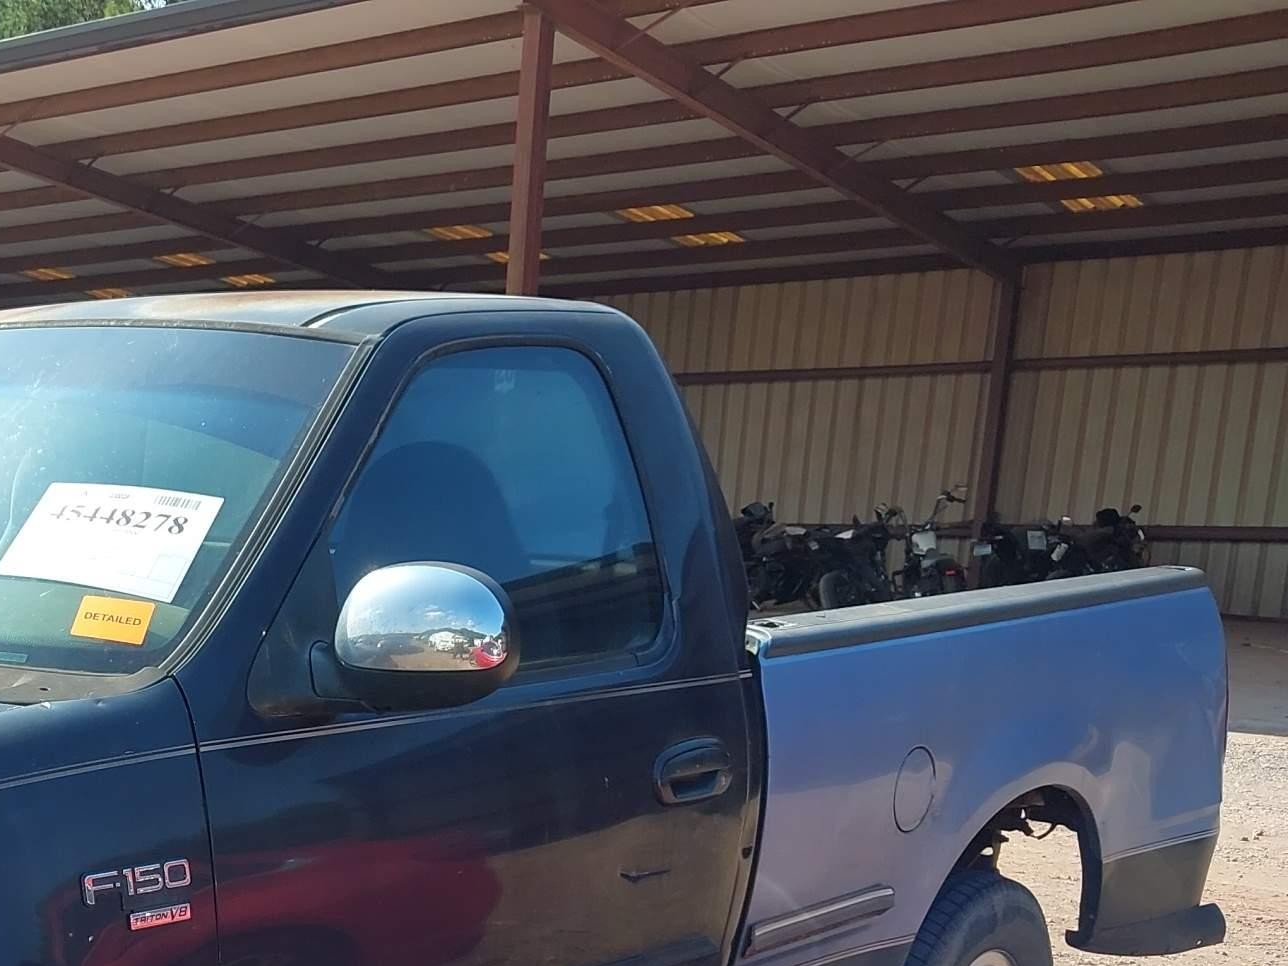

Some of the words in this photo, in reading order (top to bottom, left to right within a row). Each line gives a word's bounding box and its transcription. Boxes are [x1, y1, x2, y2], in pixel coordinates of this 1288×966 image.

[84, 611, 142, 626] DETAILED
[133, 911, 169, 926] TRITON
[171, 906, 188, 921] V8
